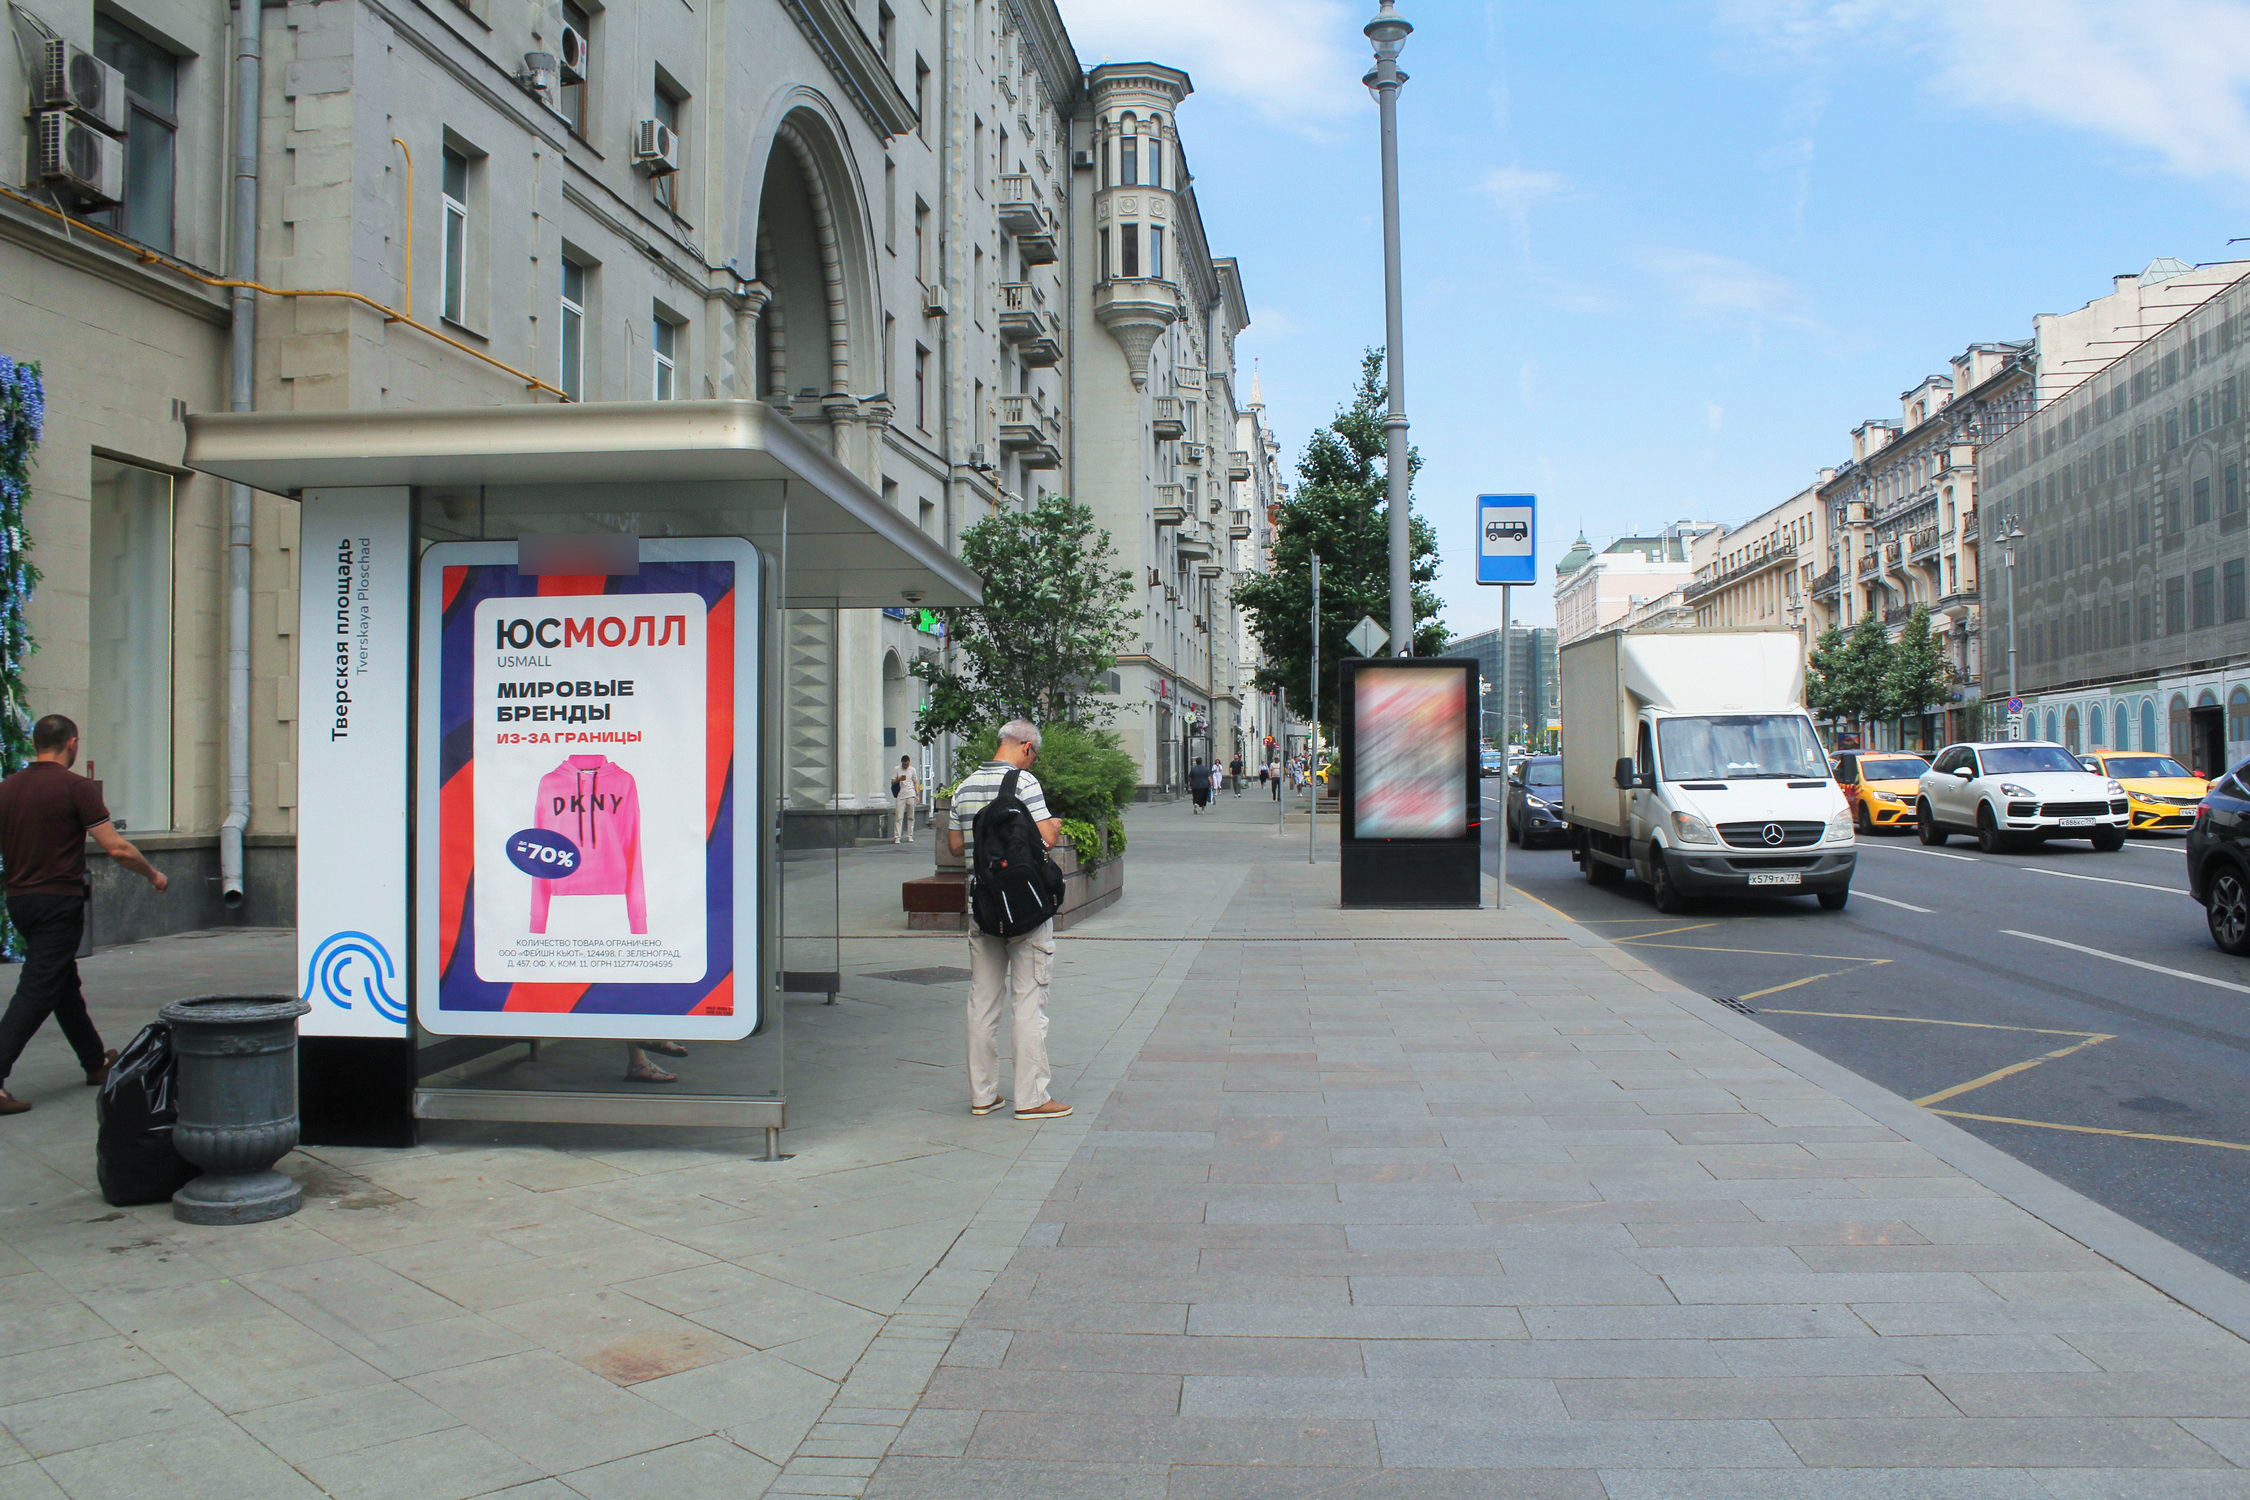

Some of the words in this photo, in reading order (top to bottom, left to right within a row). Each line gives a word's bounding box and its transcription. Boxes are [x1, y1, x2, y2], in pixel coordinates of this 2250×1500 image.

[357, 537, 371, 601] Ploschad
[336, 538, 353, 634] площадь
[356, 606, 371, 676] Tverskaya
[496, 615, 686, 650] ЮСМОЛЛ
[497, 655, 552, 668] USMALL
[331, 642, 352, 742] Тверская
[497, 679, 634, 699] МИРОВЫЕ
[497, 703, 611, 724] БРЕНДЫ
[497, 732, 551, 744] ИЗ-ЗА
[554, 730, 642, 745] ГРАНИЦЫ
[553, 794, 623, 816] DKNY
[498, 949, 517, 957] ООО
[516, 939, 571, 947] КОЛИЧЕСТВО
[573, 939, 604, 947] ТОВАРА
[590, 960, 612, 968] ОГРН
